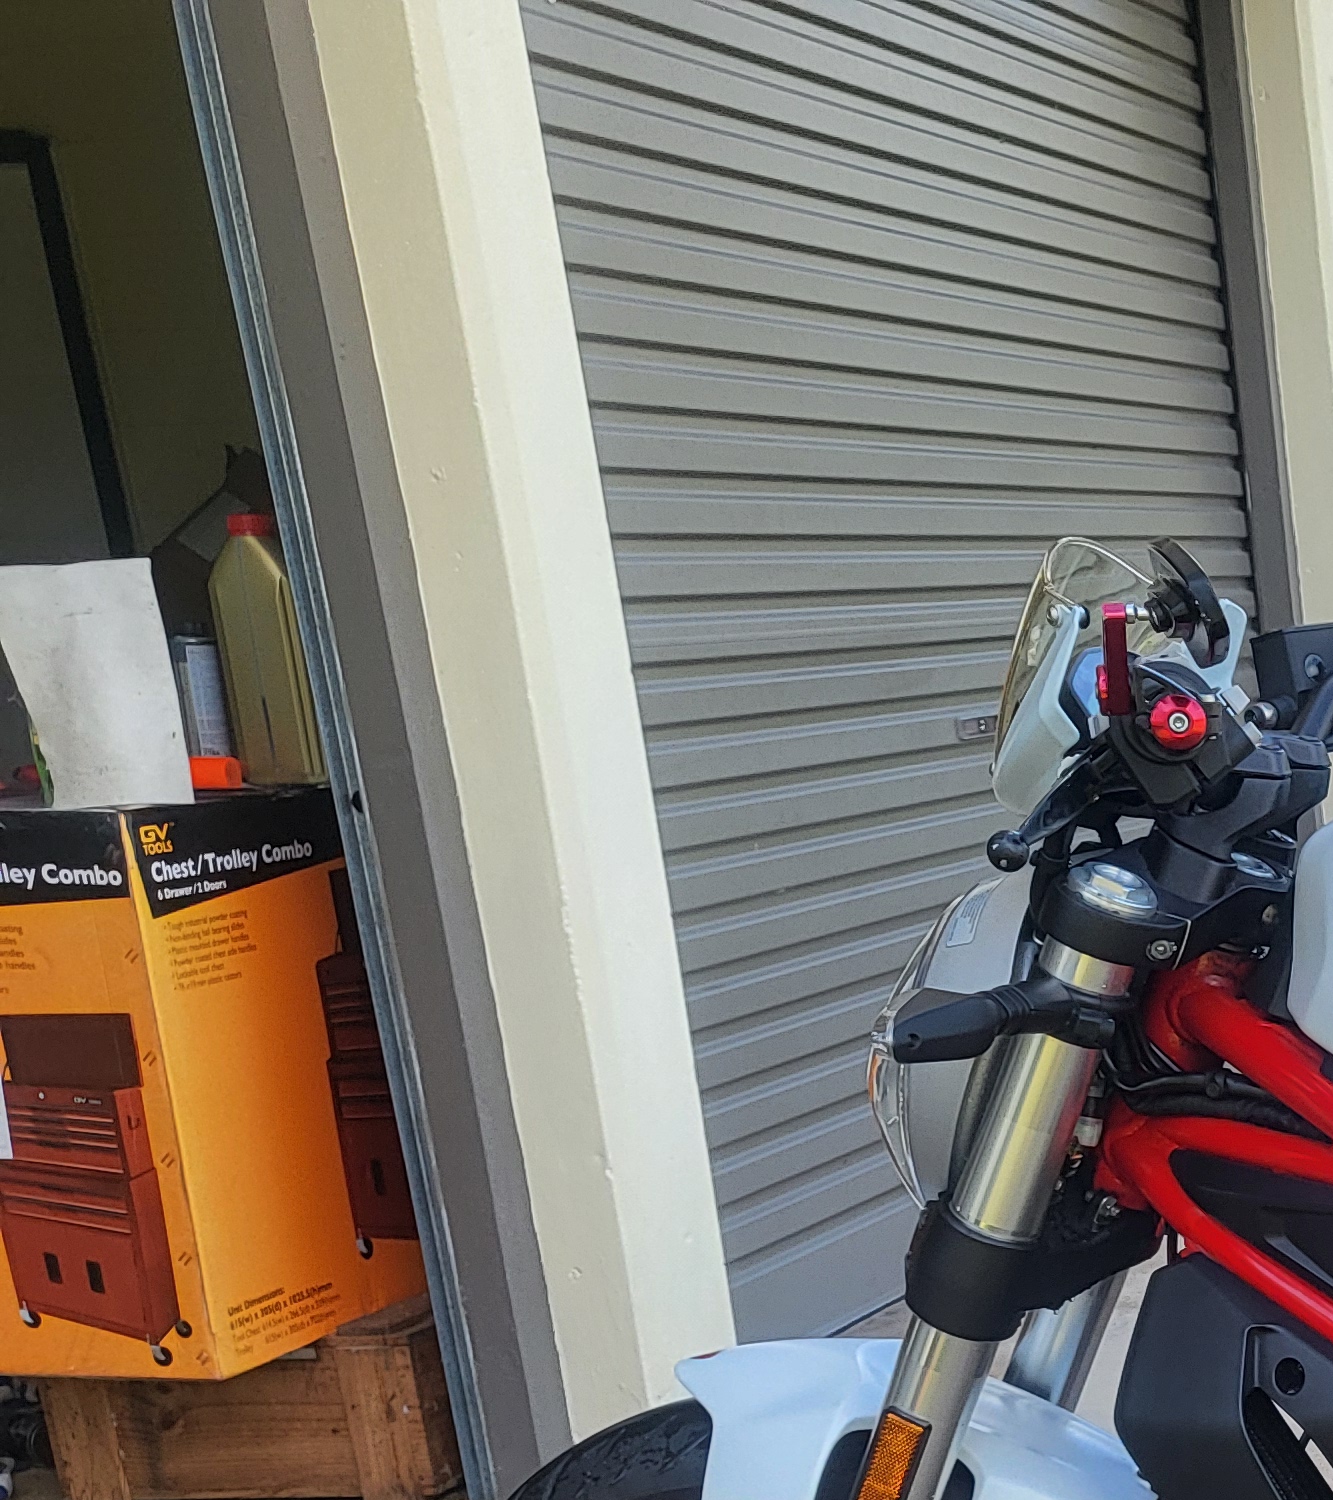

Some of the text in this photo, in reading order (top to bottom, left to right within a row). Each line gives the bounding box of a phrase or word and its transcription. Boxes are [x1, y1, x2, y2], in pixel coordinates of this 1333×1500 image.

[139, 823, 168, 843] GV
[142, 840, 173, 856] TOOLS
[262, 839, 312, 864] Combo
[41, 863, 122, 886] Combo
[157, 889, 163, 901] 6
[203, 879, 227, 893] Doors
